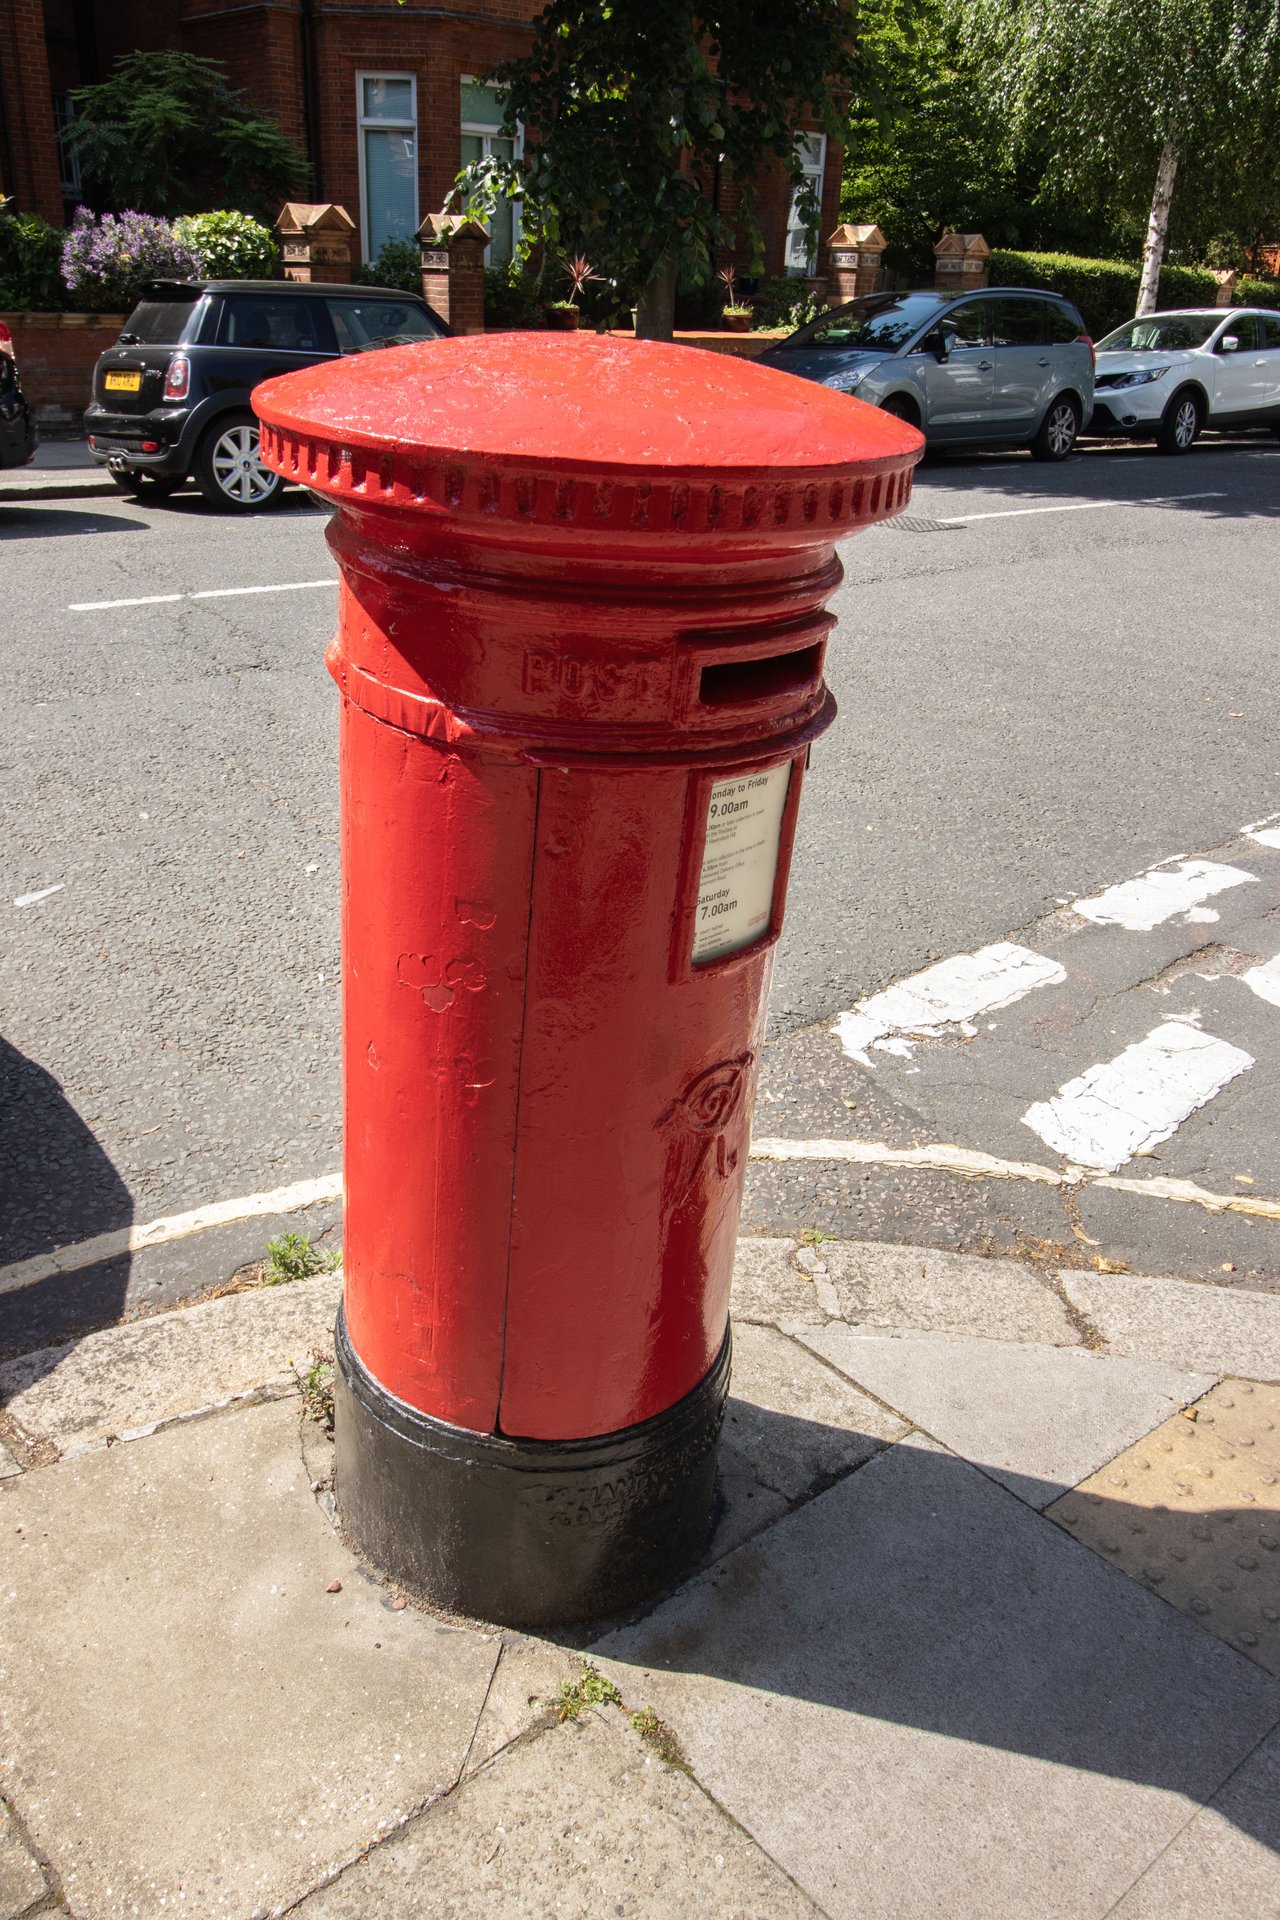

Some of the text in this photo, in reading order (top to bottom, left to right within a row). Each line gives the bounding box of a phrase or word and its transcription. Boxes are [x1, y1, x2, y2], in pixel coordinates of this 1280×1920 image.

[522, 648, 661, 702] POST
[711, 776, 769, 800] onday to Friday
[710, 800, 749, 818] 9.00am
[697, 888, 730, 906] Saturday
[701, 900, 738, 921] 7.00am
